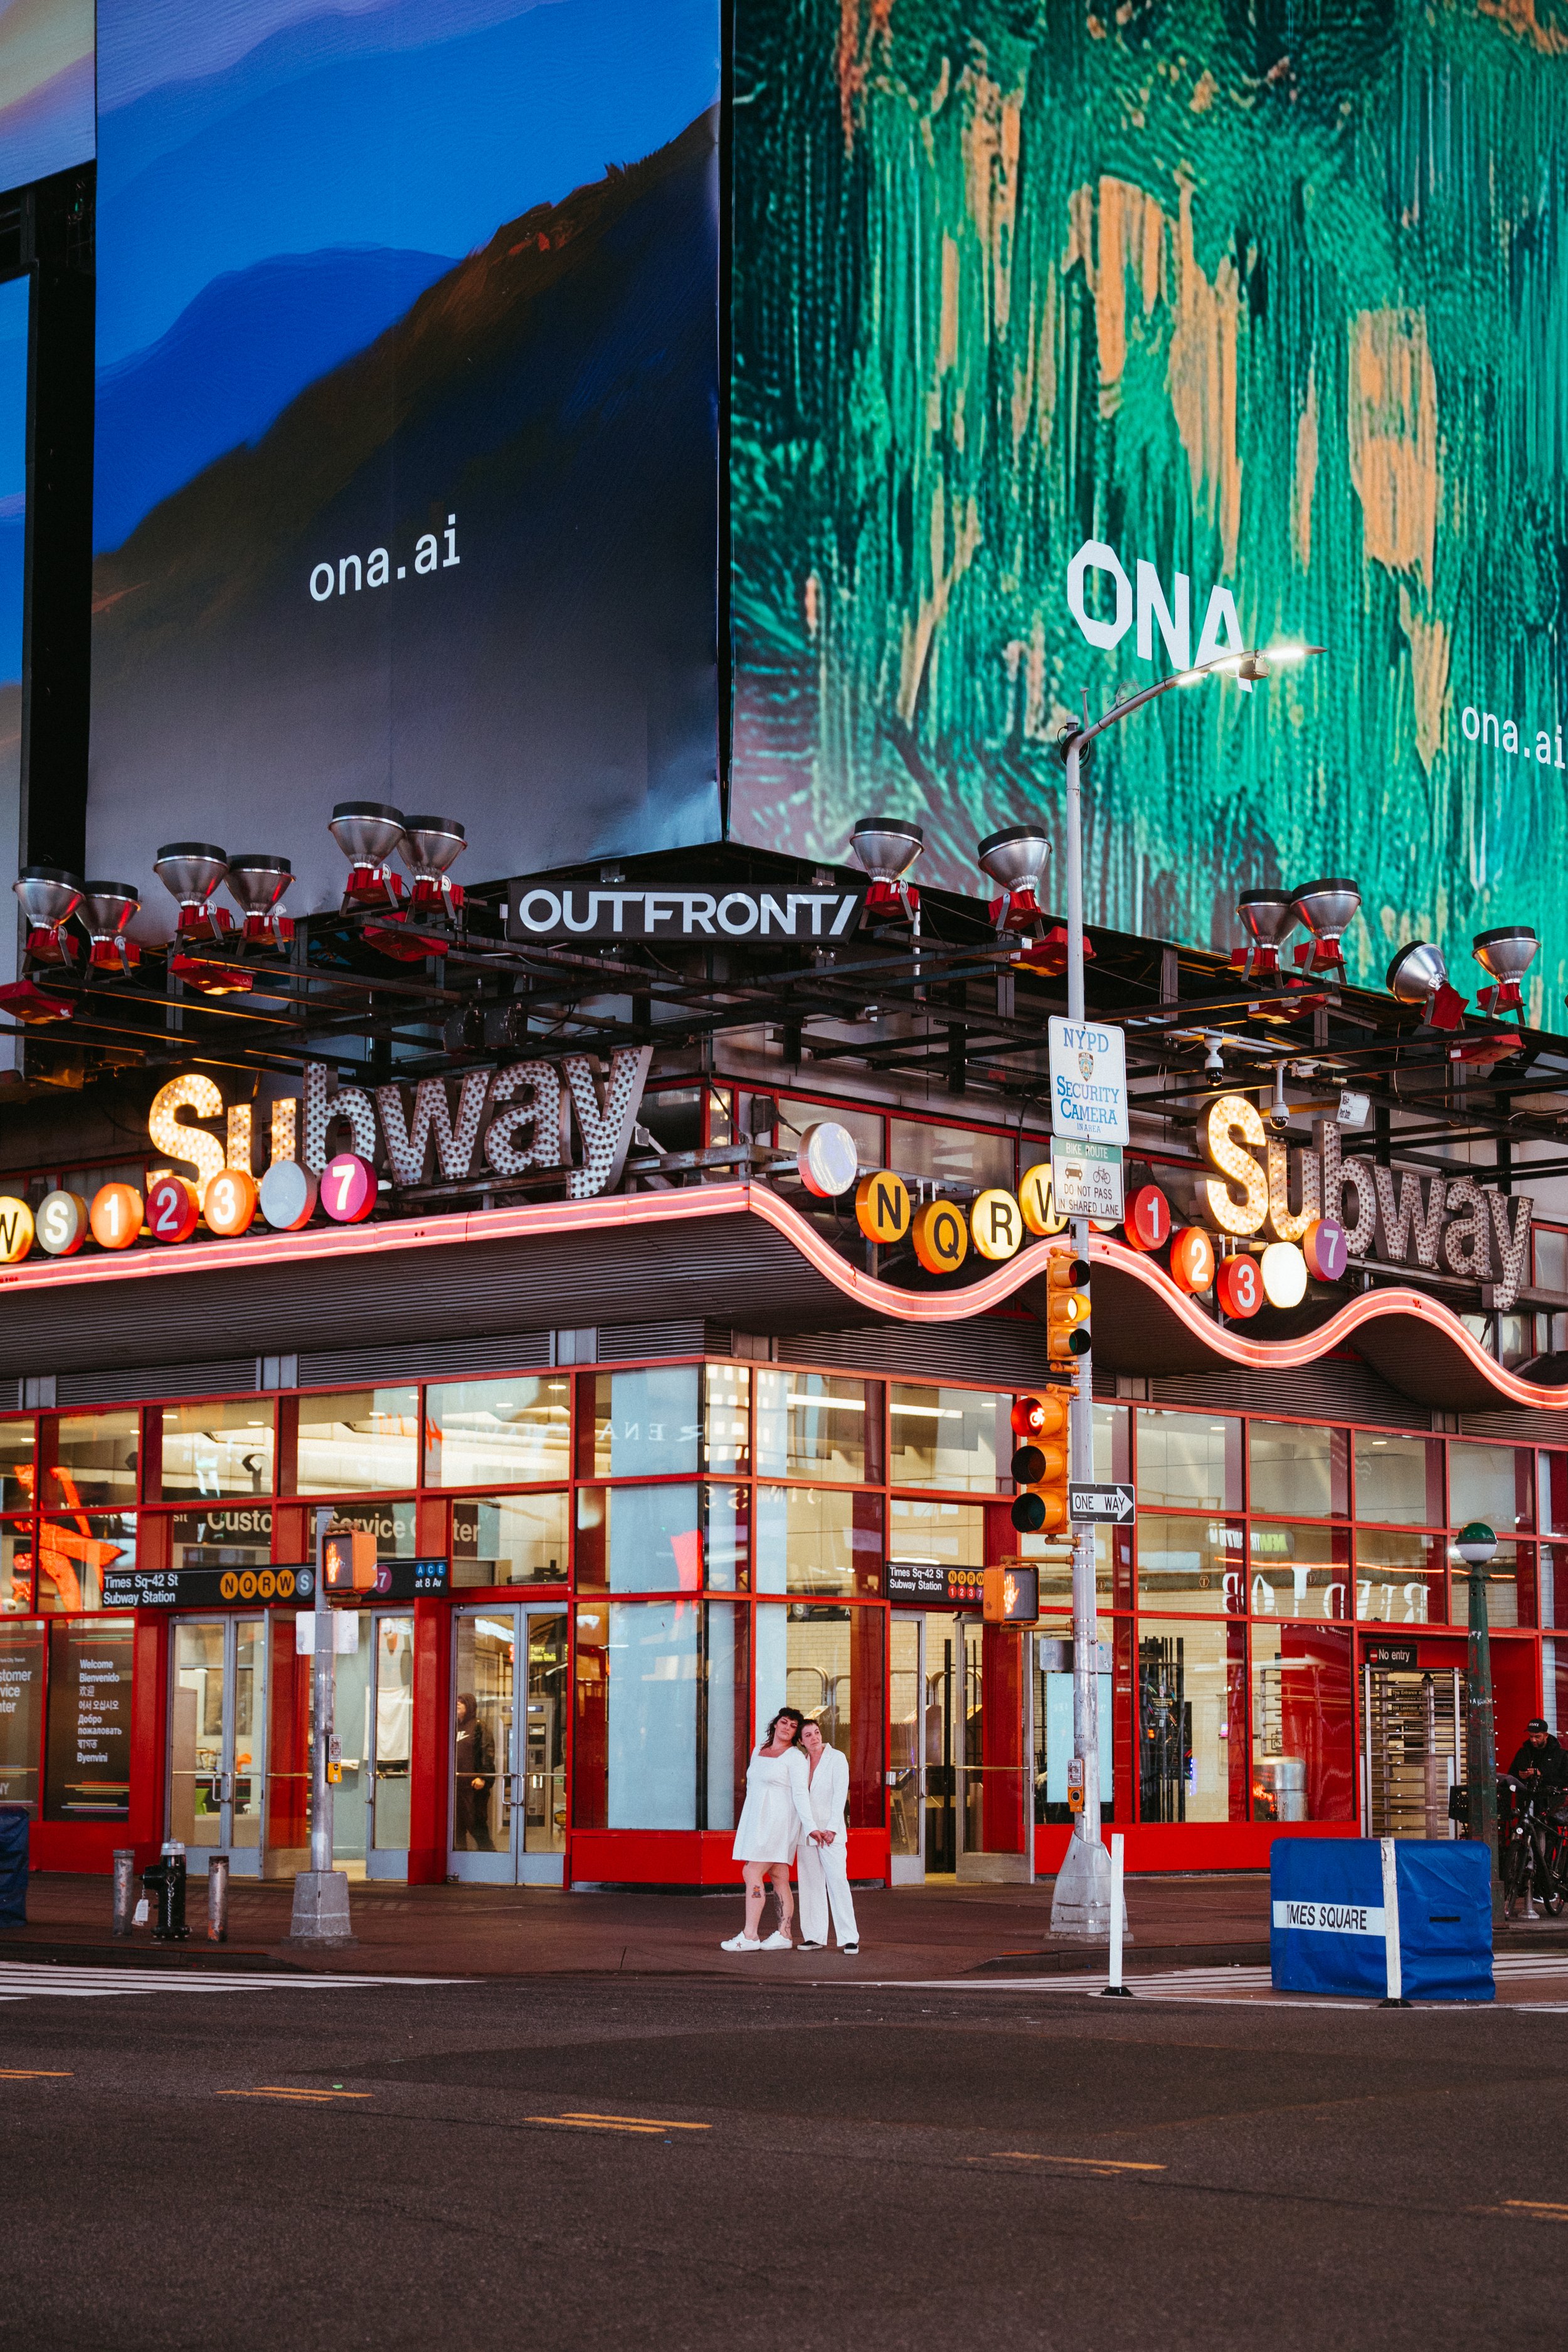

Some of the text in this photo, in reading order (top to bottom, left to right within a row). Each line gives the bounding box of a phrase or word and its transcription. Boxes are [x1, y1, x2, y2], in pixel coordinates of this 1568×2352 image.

[310, 514, 460, 601] ona.ai
[1067, 539, 1253, 692] ONA
[1462, 706, 1565, 770] ona.ai
[1064, 1027, 1109, 1053] NYPD
[147, 1045, 653, 1199] Subway
[1077, 1123, 1101, 1133] IN AREA
[1066, 1142, 1108, 1160] BIKE ROUTE
[1064, 1184, 1112, 1200] DO NOT PASS
[45, 1200, 69, 1244] S
[104, 1194, 119, 1237] 1
[157, 1187, 178, 1232] 2
[213, 1179, 236, 1225] 3
[332, 1164, 356, 1210] 7
[1058, 1197, 1119, 1216] IN SHARED LANE
[1195, 1095, 1534, 1311] Subway
[877, 1183, 902, 1230] N
[934, 1212, 960, 1261] Q
[991, 1200, 1013, 1246] R
[1147, 1197, 1159, 1239] 1
[1190, 1237, 1209, 1283] 2
[1237, 1264, 1255, 1308] 3
[1323, 1229, 1339, 1269] 7
[1075, 1495, 1125, 1512] ONE WAY
[418, 1565, 443, 1574] A C E
[890, 1567, 943, 1579] Times Sq-42 St
[104, 1574, 179, 1589] Times Sq-42 St
[225, 1572, 387, 1592] N Q R W S 7
[415, 1577, 442, 1587] at 8 Av
[889, 1579, 942, 1591] Subway Station
[103, 1591, 176, 1606] Subway Station
[80, 1658, 114, 1669] Welcome
[1379, 1648, 1410, 1663] No entry
[79, 1672, 120, 1683] Bienvenido
[78, 1700, 119, 1711] 어서 오십시오
[78, 1714, 102, 1726] Добро
[77, 1752, 108, 1764] Byenvini
[1319, 1906, 1367, 1930] SQUARE
